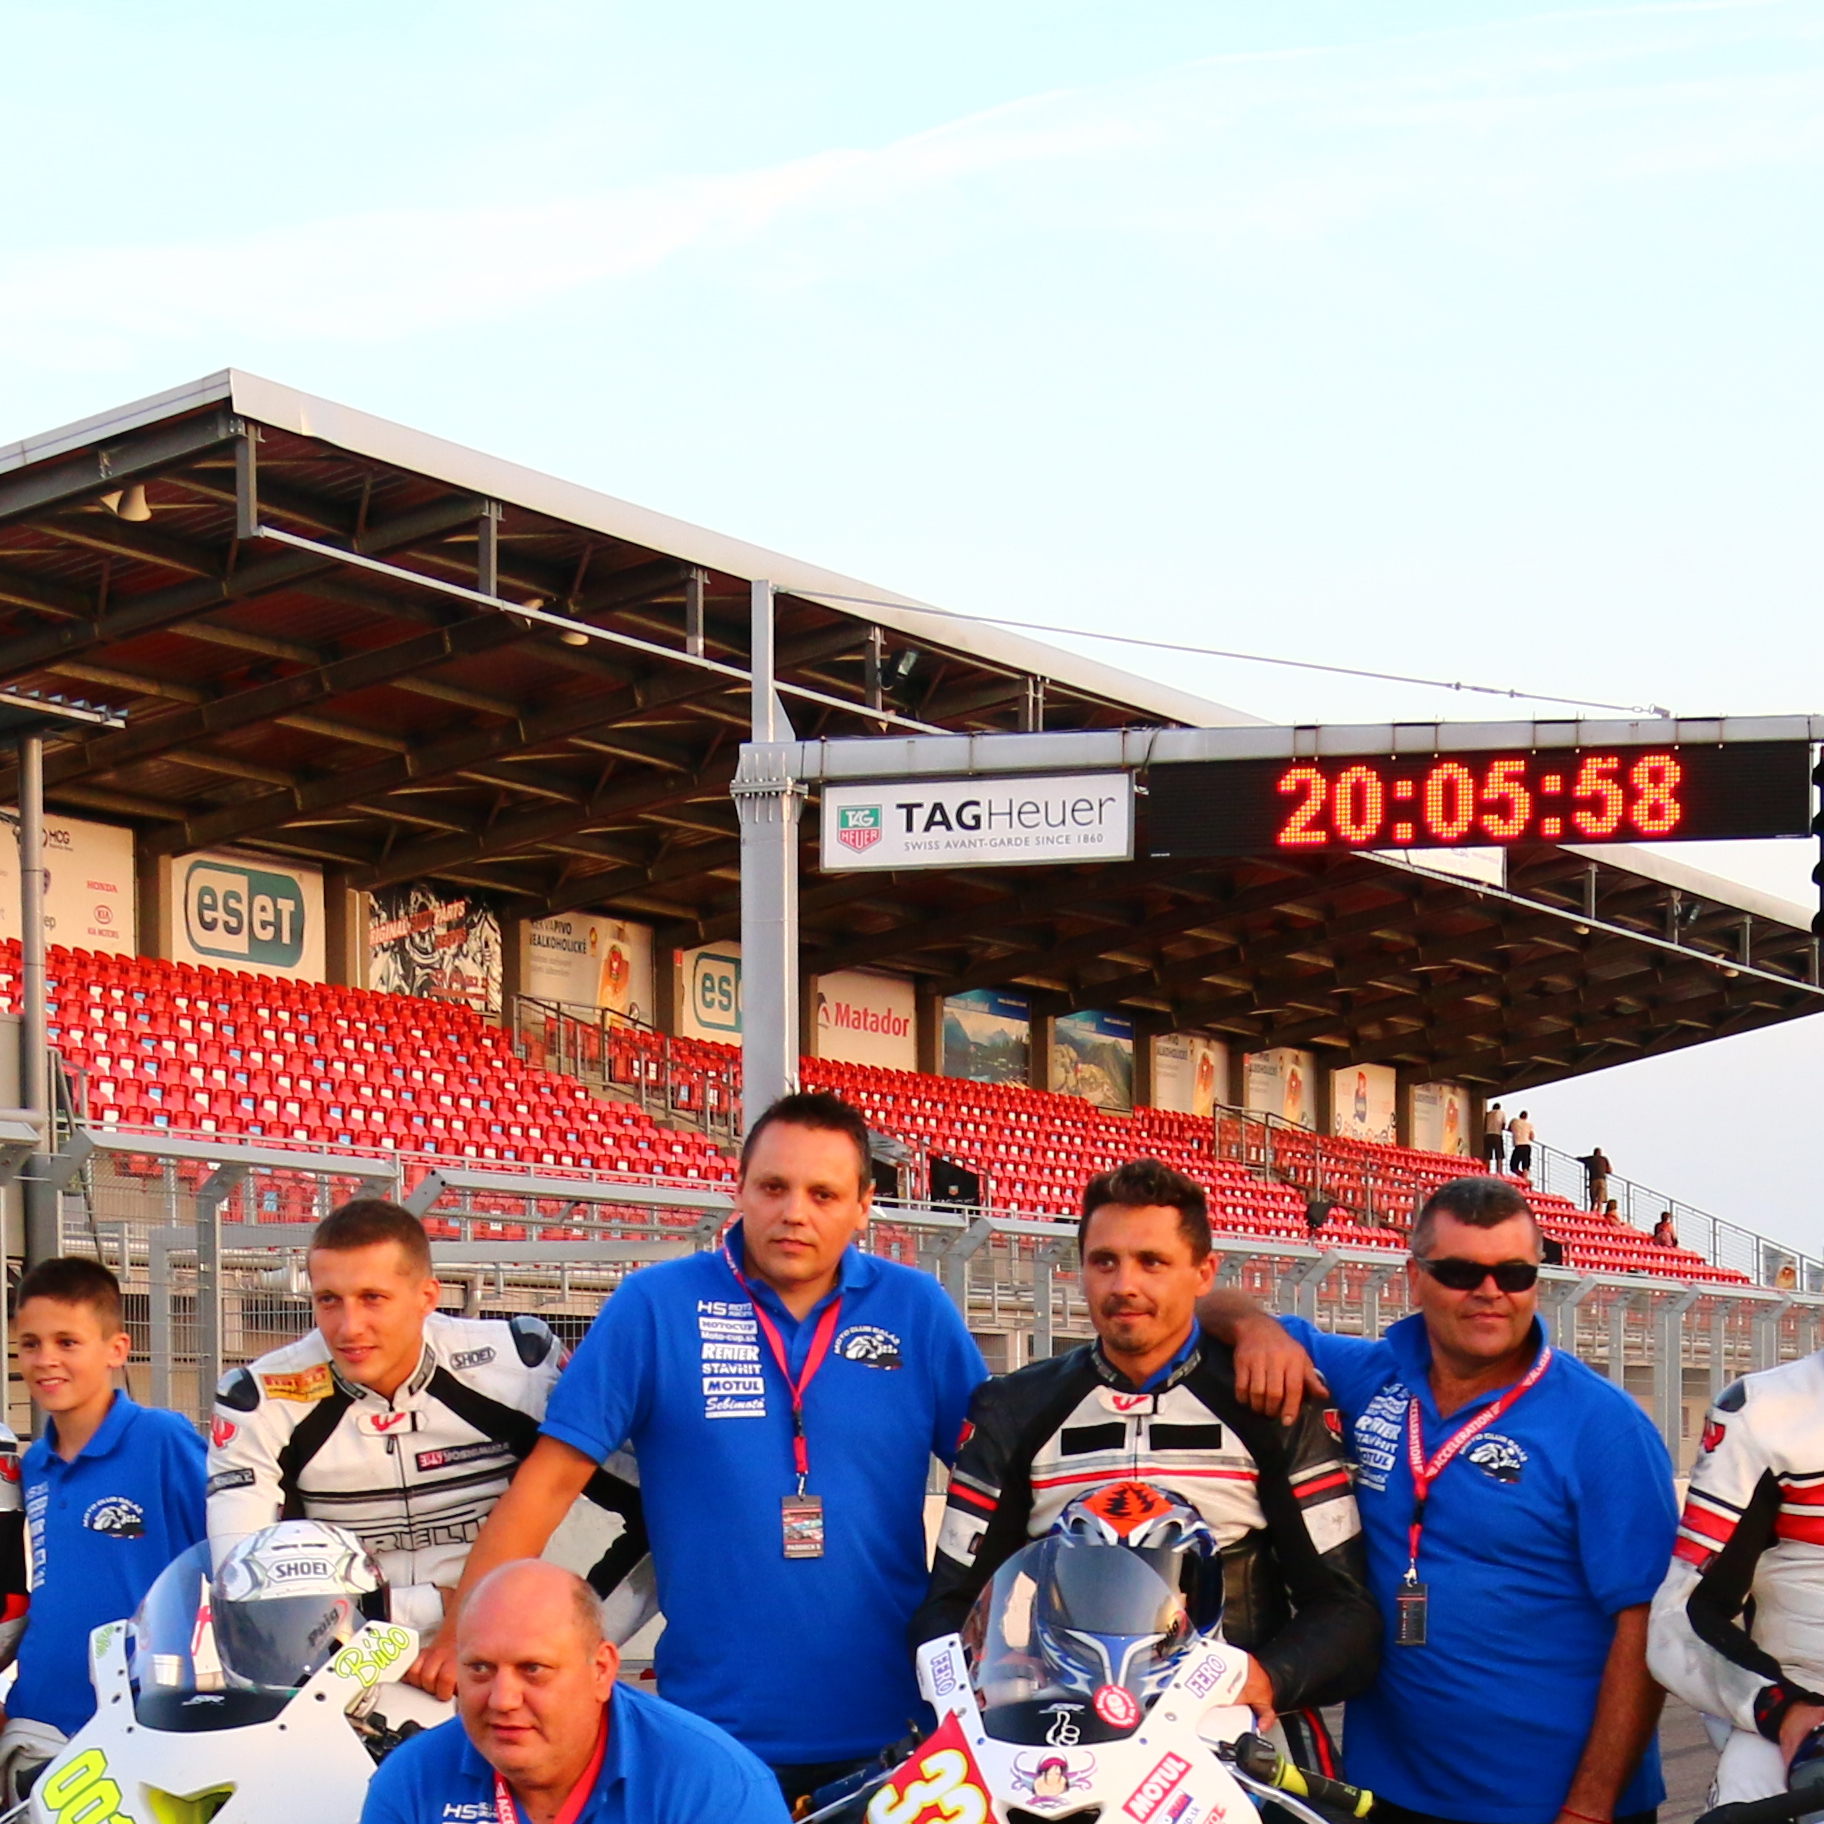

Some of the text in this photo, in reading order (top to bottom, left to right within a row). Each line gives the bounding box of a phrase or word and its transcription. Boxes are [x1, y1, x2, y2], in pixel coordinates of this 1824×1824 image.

[1278, 754, 1681, 845] 20:05:58
[49, 829, 70, 845] MCG
[840, 829, 879, 849] HEUER
[904, 833, 1103, 852] SWISS AVANT-GARDE SINCE 1860
[87, 880, 119, 893] HONDA
[834, 1002, 910, 1038] Matador
[697, 1300, 727, 1316] HS
[453, 1350, 492, 1369] SHOEI
[701, 1342, 760, 1361] RENTER
[702, 1363, 763, 1375] STAVHIT
[707, 1379, 760, 1392] MOTUL
[1434, 1410, 1495, 1469] ACCELERATION
[276, 1561, 327, 1578] SHOEI
[308, 1607, 339, 1647] Puig
[931, 1650, 955, 1697] FERO
[1184, 1654, 1226, 1700] FERO
[1127, 1755, 1189, 1822] MOTUL
[442, 1803, 477, 1819] HS
